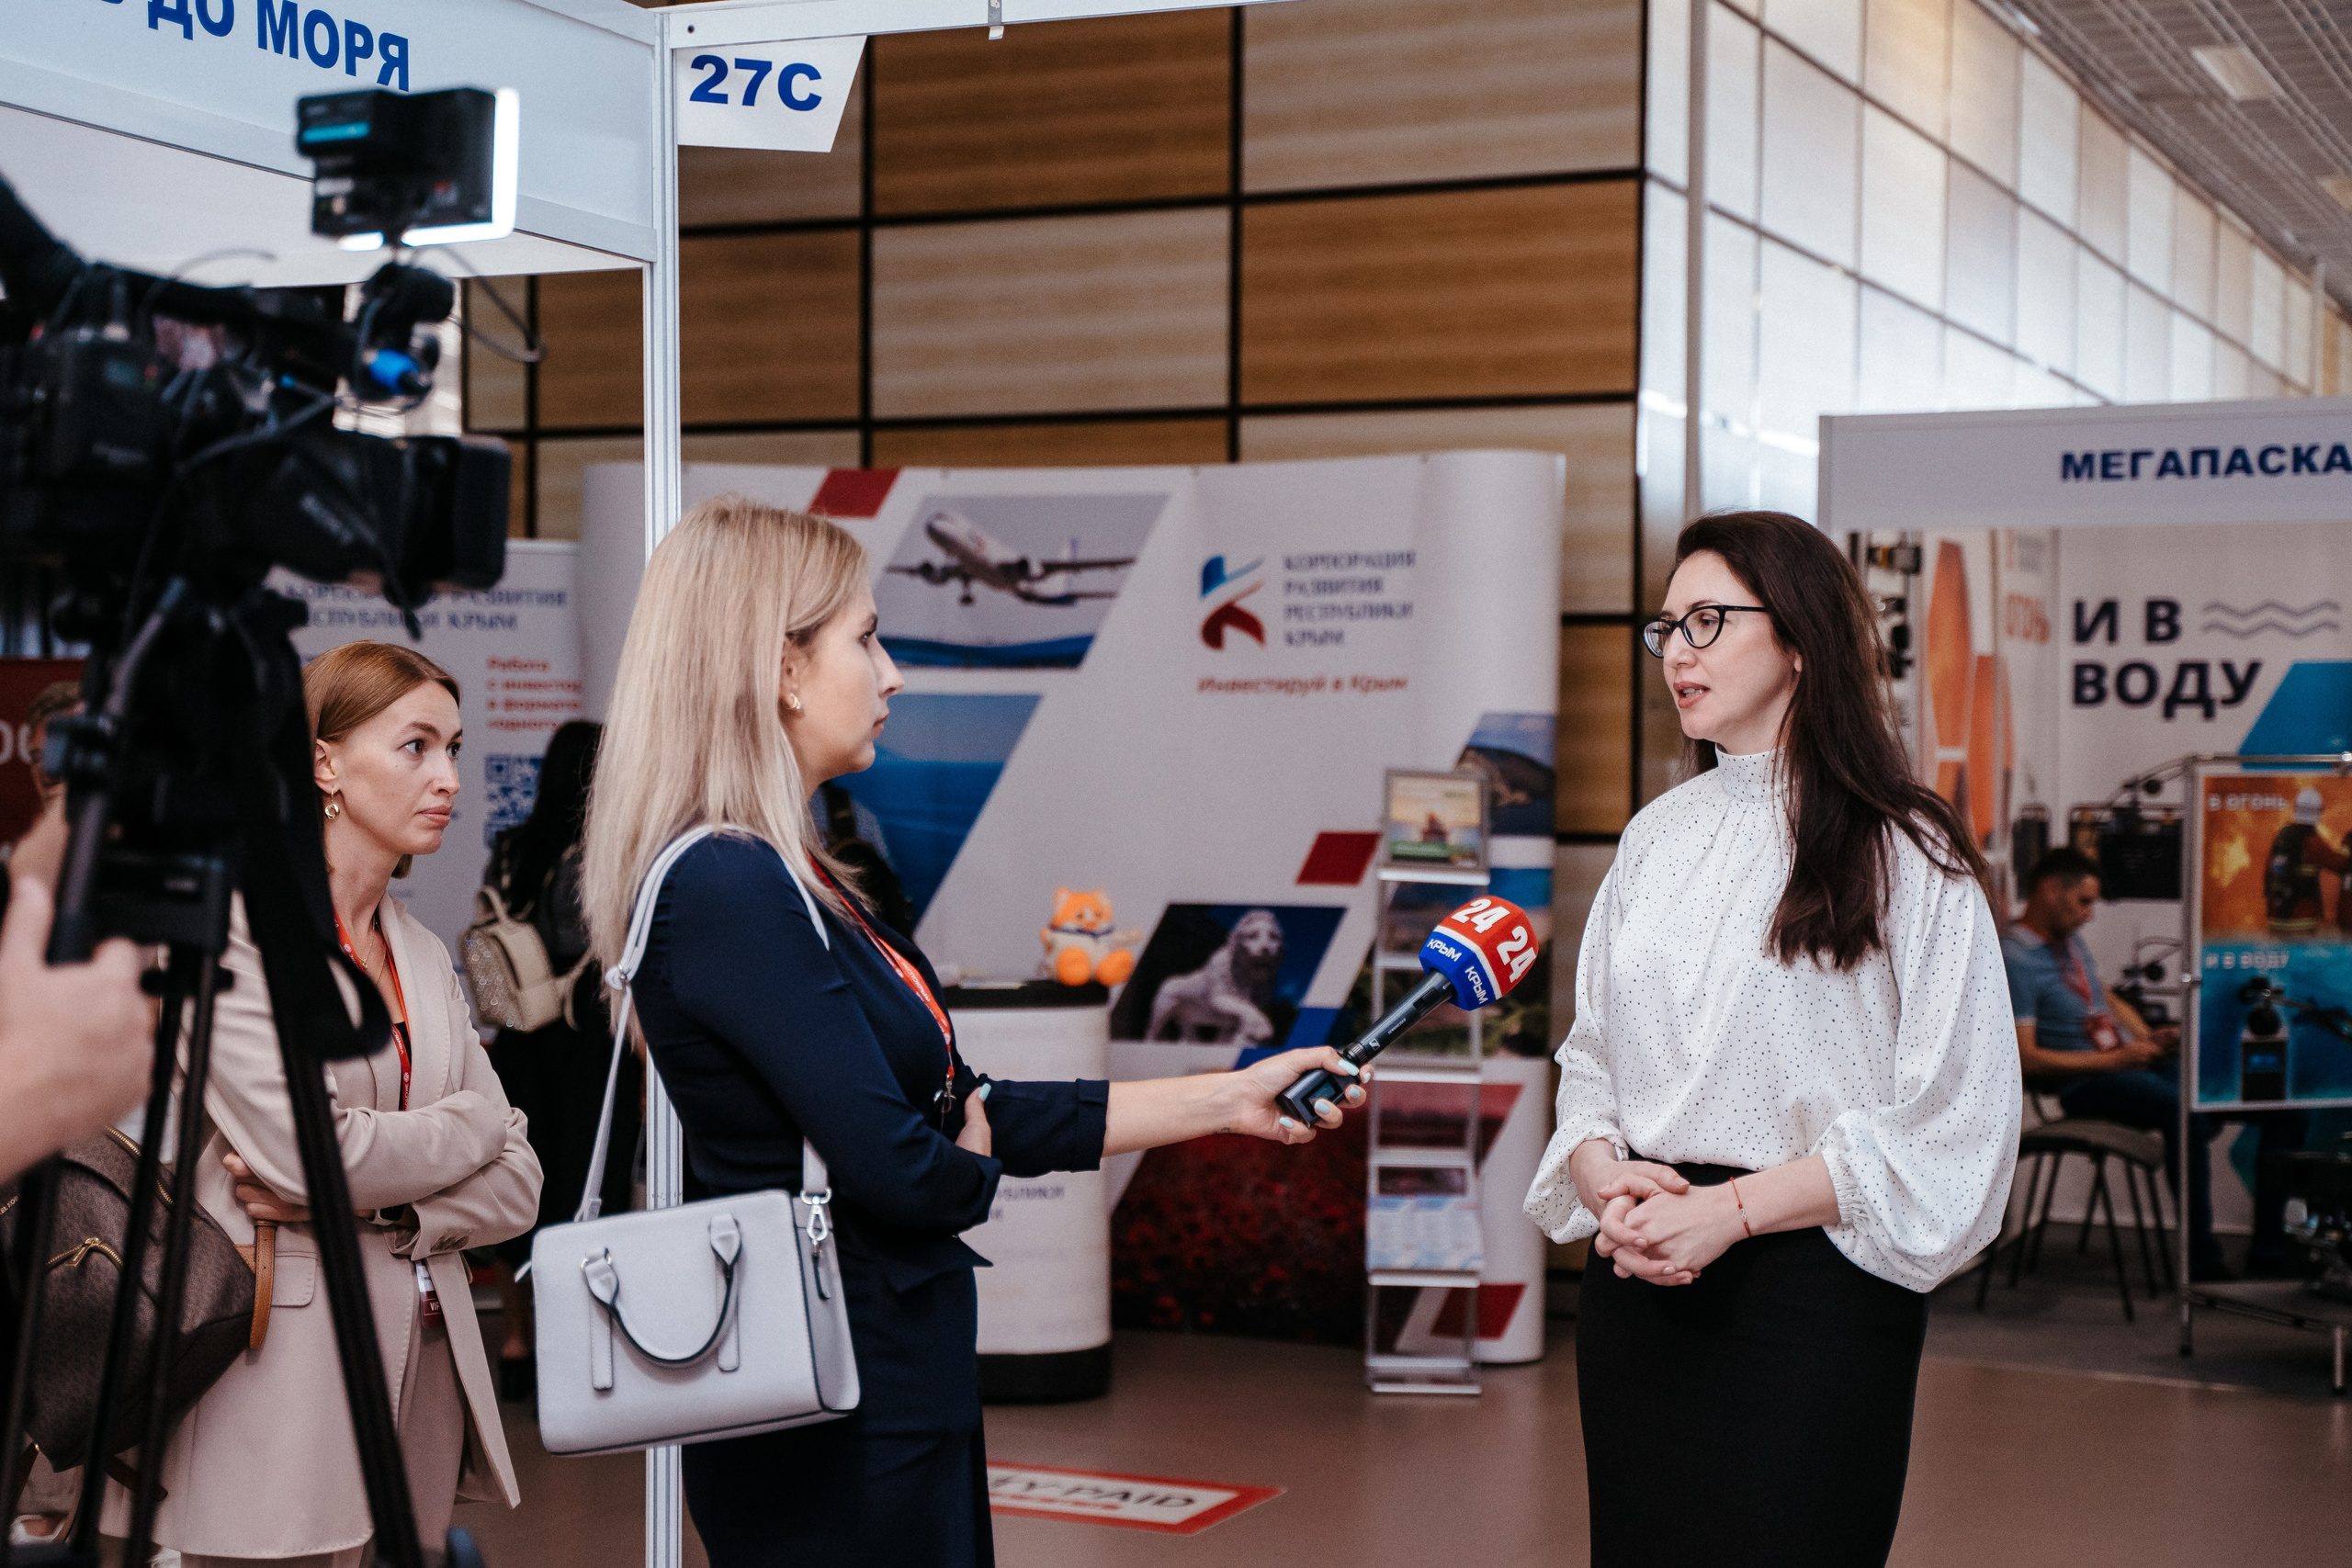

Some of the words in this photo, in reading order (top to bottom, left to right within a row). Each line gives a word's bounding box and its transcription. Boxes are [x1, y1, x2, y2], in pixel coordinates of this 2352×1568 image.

[257, 0, 410, 93] МОРЯ
[2061, 443, 2352, 482] МЕГАПАСКА
[2074, 599, 2119, 644] И
[2144, 599, 2182, 644] В
[2073, 660, 2262, 720] ВОДУ
[1451, 898, 1510, 934] 24
[1426, 938, 1463, 963] КРЫМ
[1496, 925, 1537, 984] 24
[1464, 965, 1488, 1005] КРЫМ
[430, 1302, 440, 1311] VIP
